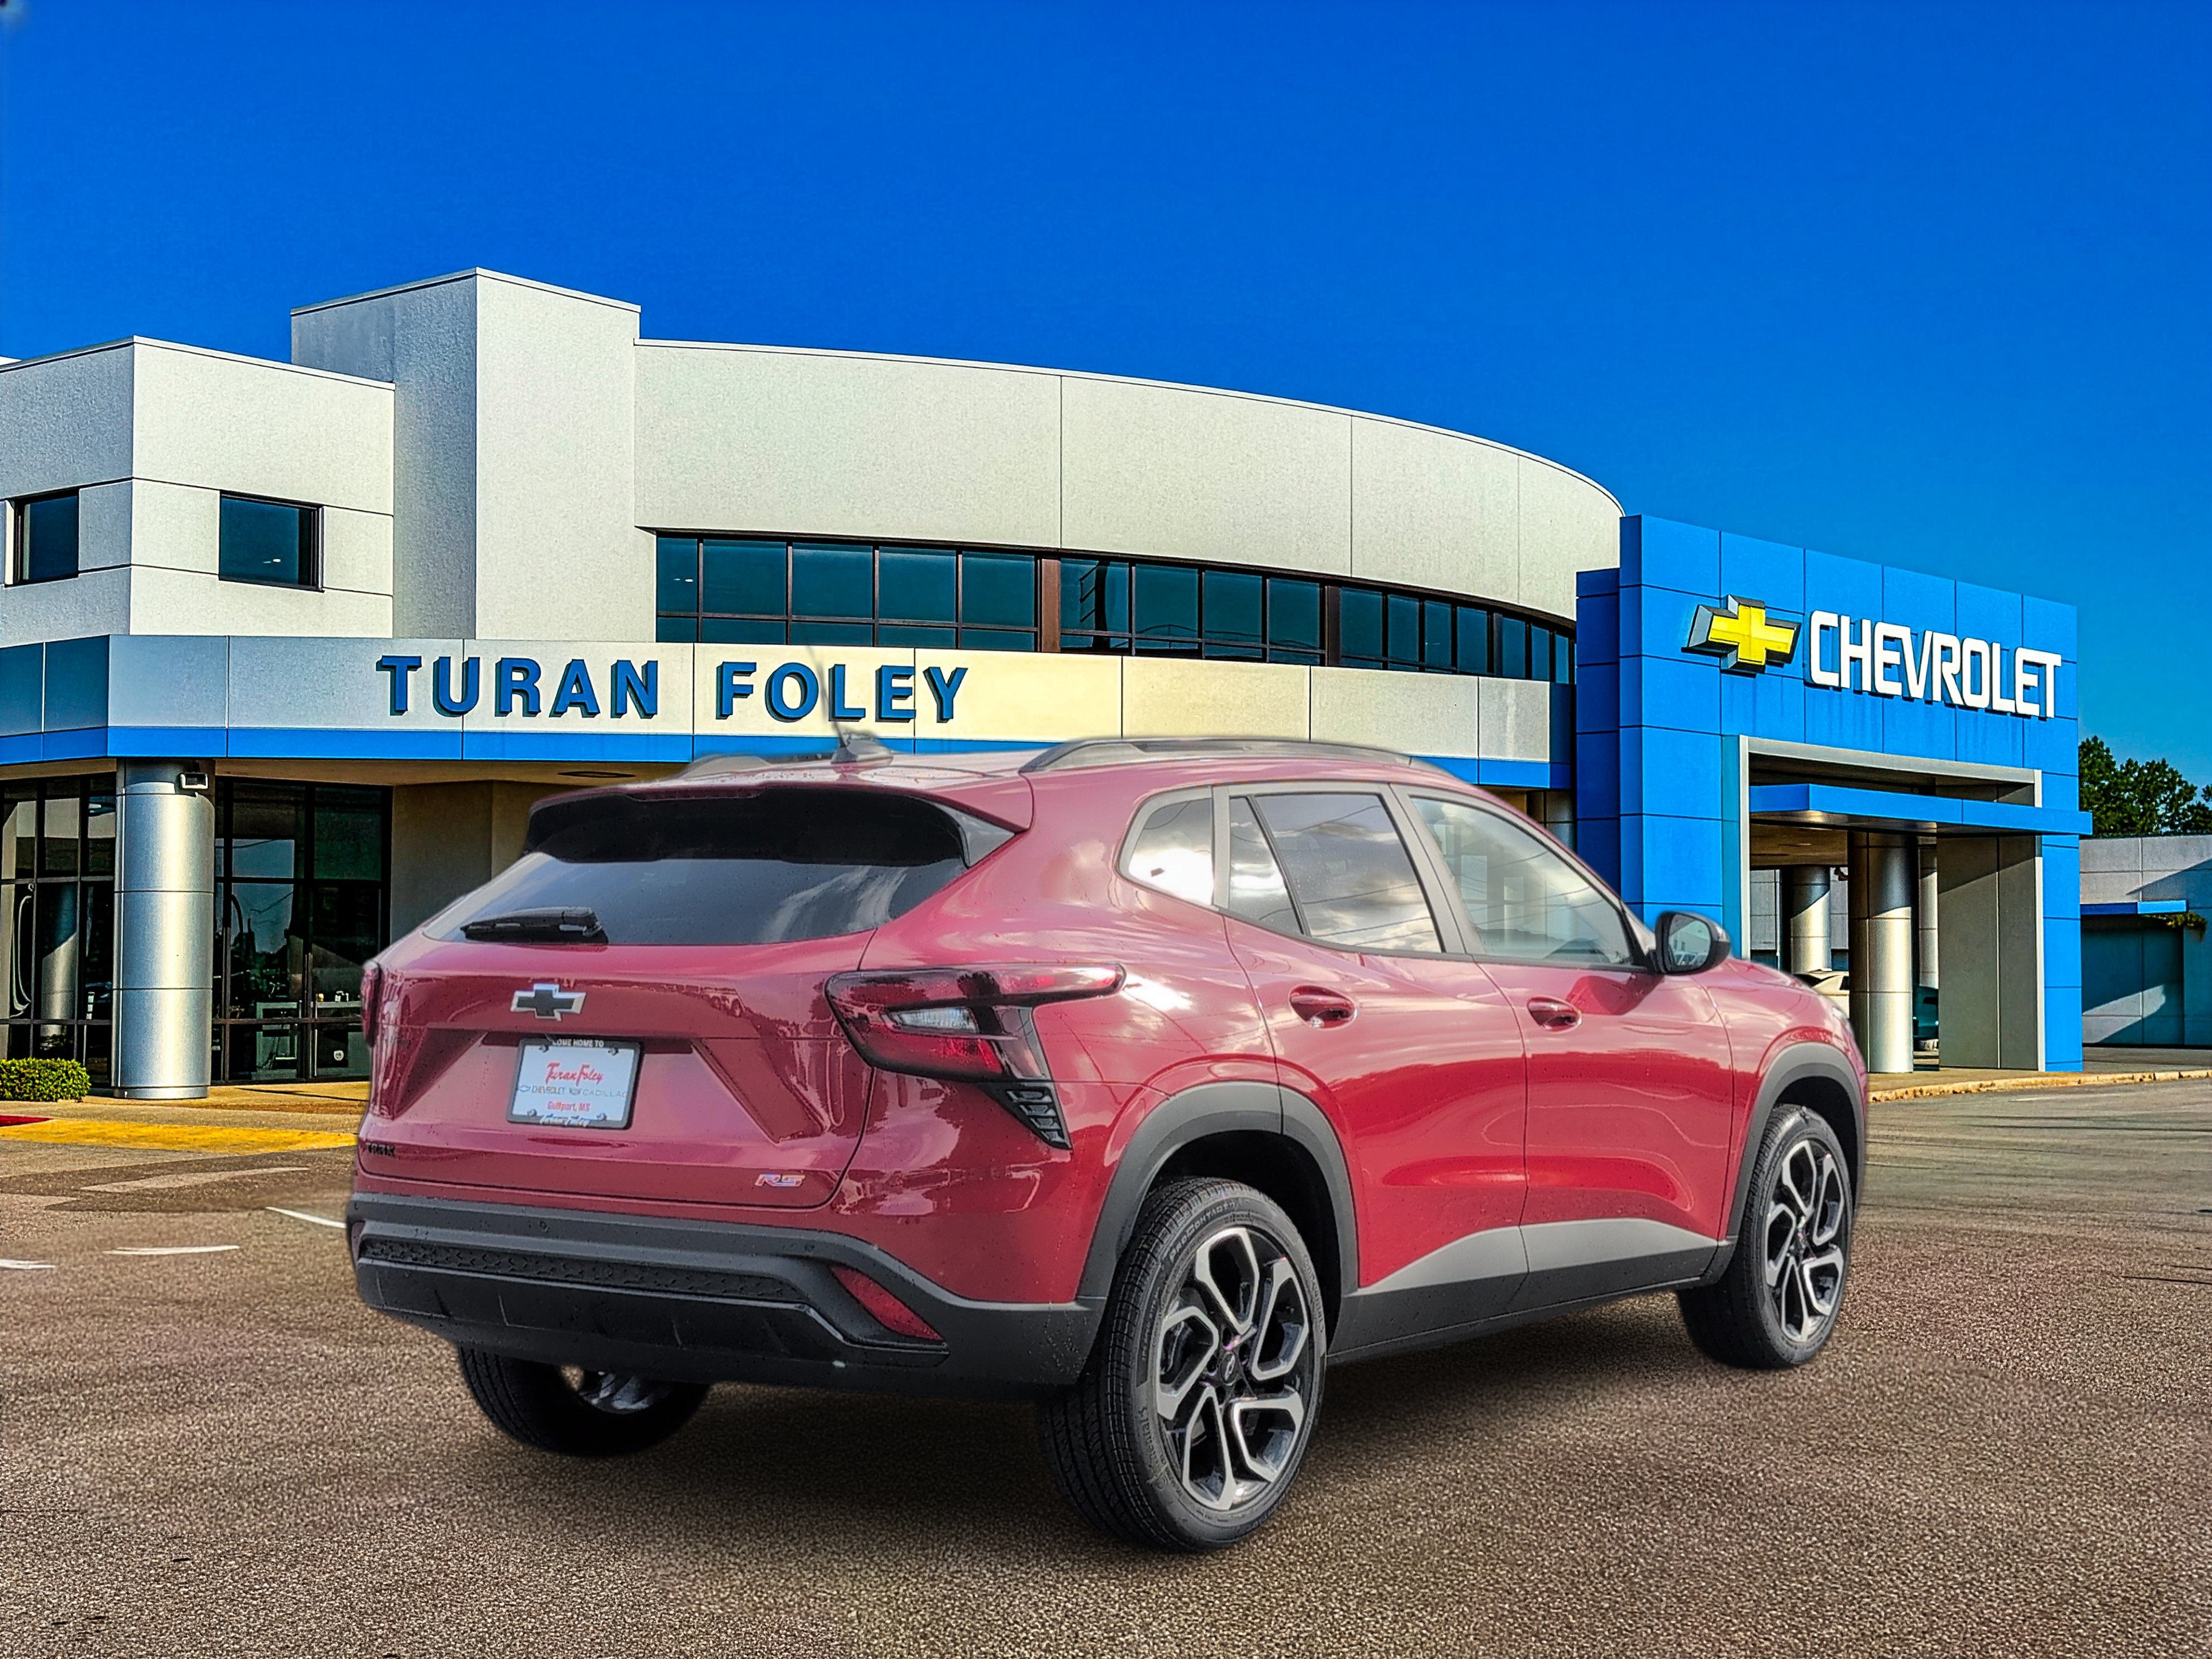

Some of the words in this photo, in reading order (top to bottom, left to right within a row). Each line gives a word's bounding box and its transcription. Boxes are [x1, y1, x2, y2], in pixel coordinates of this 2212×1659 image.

[1810, 610, 2062, 719] CHEVROLET
[376, 655, 659, 720] TURAN
[716, 660, 969, 724] FOLEY
[573, 1039, 594, 1047] HOME
[545, 1061, 577, 1085] Turan
[576, 1063, 603, 1086] Foley
[582, 1089, 627, 1098] CADILLAC
[578, 1102, 591, 1112] MS
[754, 1173, 806, 1187] RS
